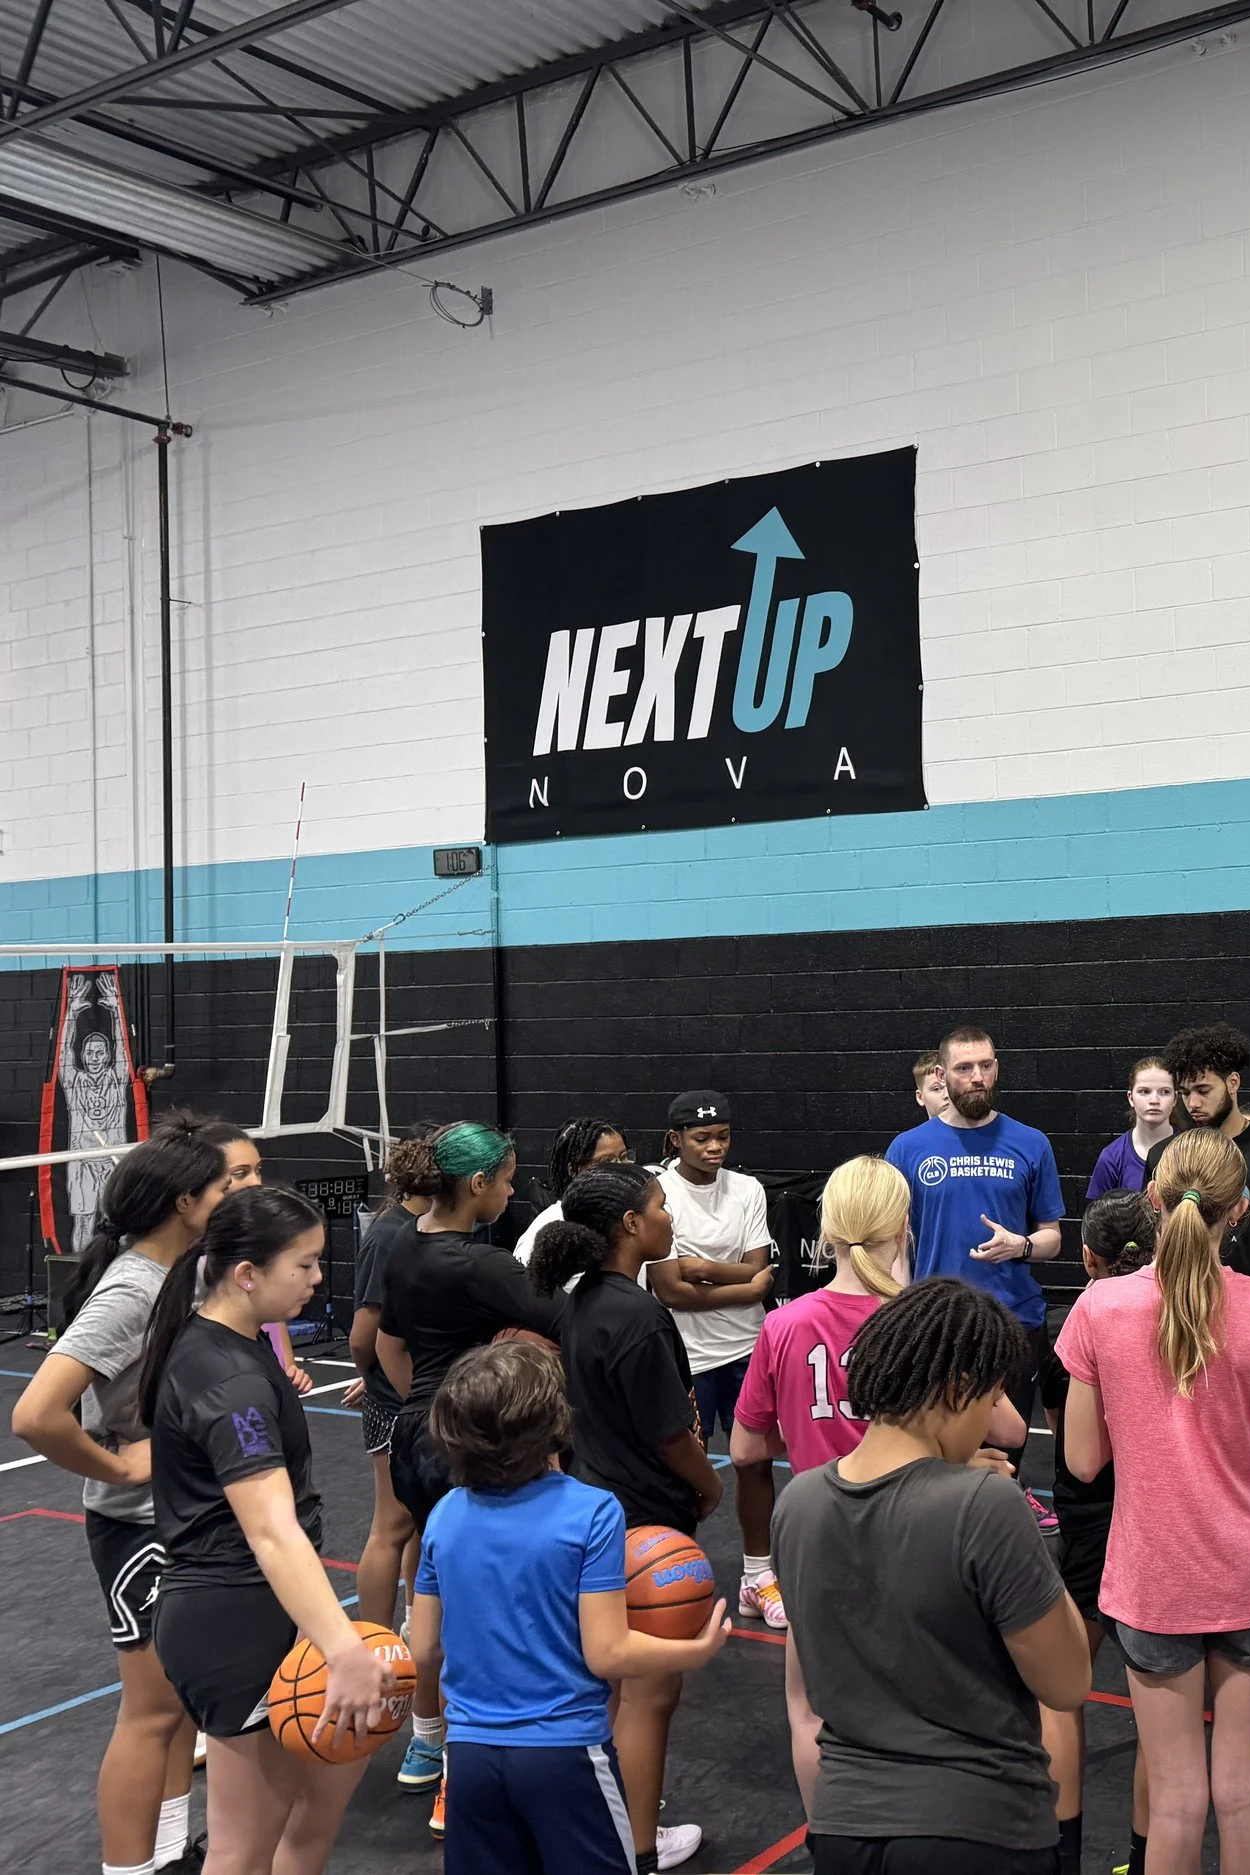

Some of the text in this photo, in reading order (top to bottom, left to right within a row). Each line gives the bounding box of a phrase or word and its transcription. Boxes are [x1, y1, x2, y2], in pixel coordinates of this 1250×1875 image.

[533, 560, 854, 756] NEXT UP
[949, 1156, 1015, 1169] CHRIS LEWIS
[926, 1170, 940, 1179] CLB
[950, 1166, 1015, 1180] BASKETBALL
